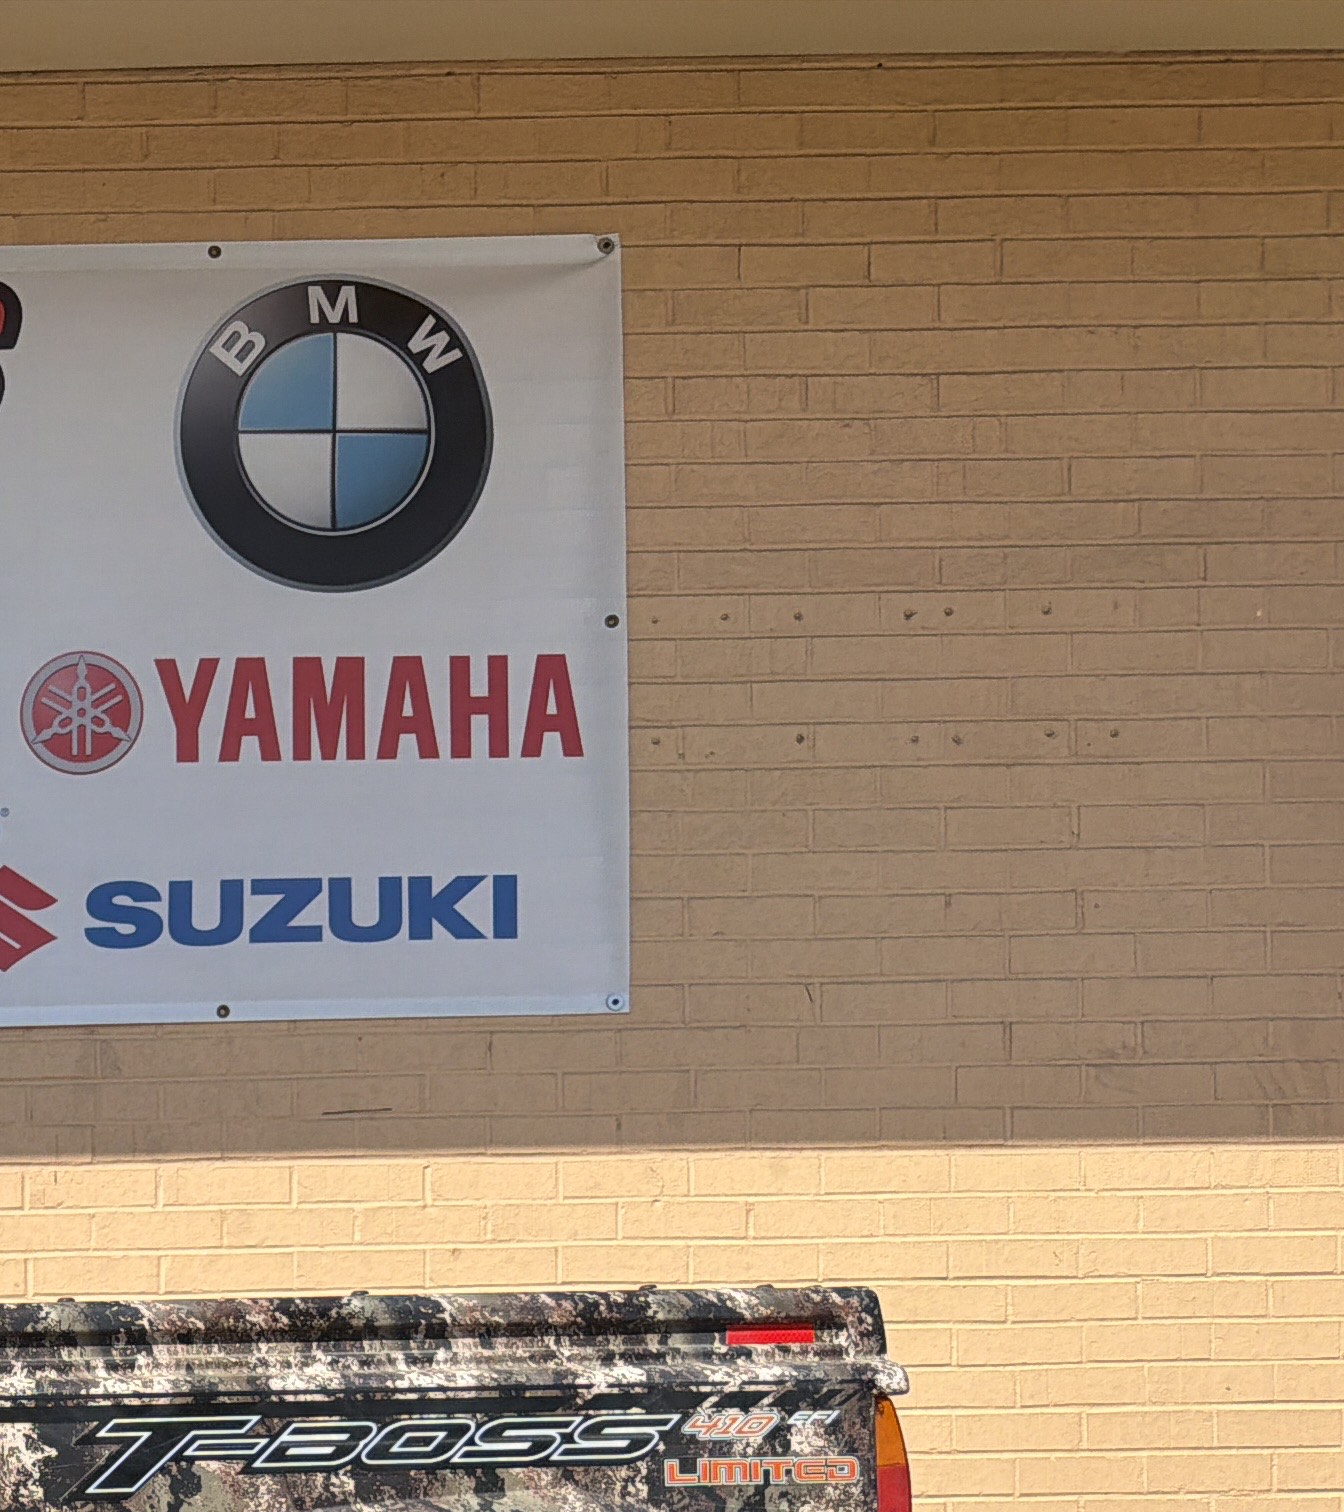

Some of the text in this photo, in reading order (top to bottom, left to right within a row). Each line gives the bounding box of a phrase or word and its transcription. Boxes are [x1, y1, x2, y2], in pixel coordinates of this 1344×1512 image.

[153, 654, 585, 764] YAMAHA
[83, 873, 518, 950] SUZUKI
[85, 1413, 682, 1494] T-BOSS
[682, 1411, 780, 1441] 410
[664, 1456, 861, 1487] LIMITED
